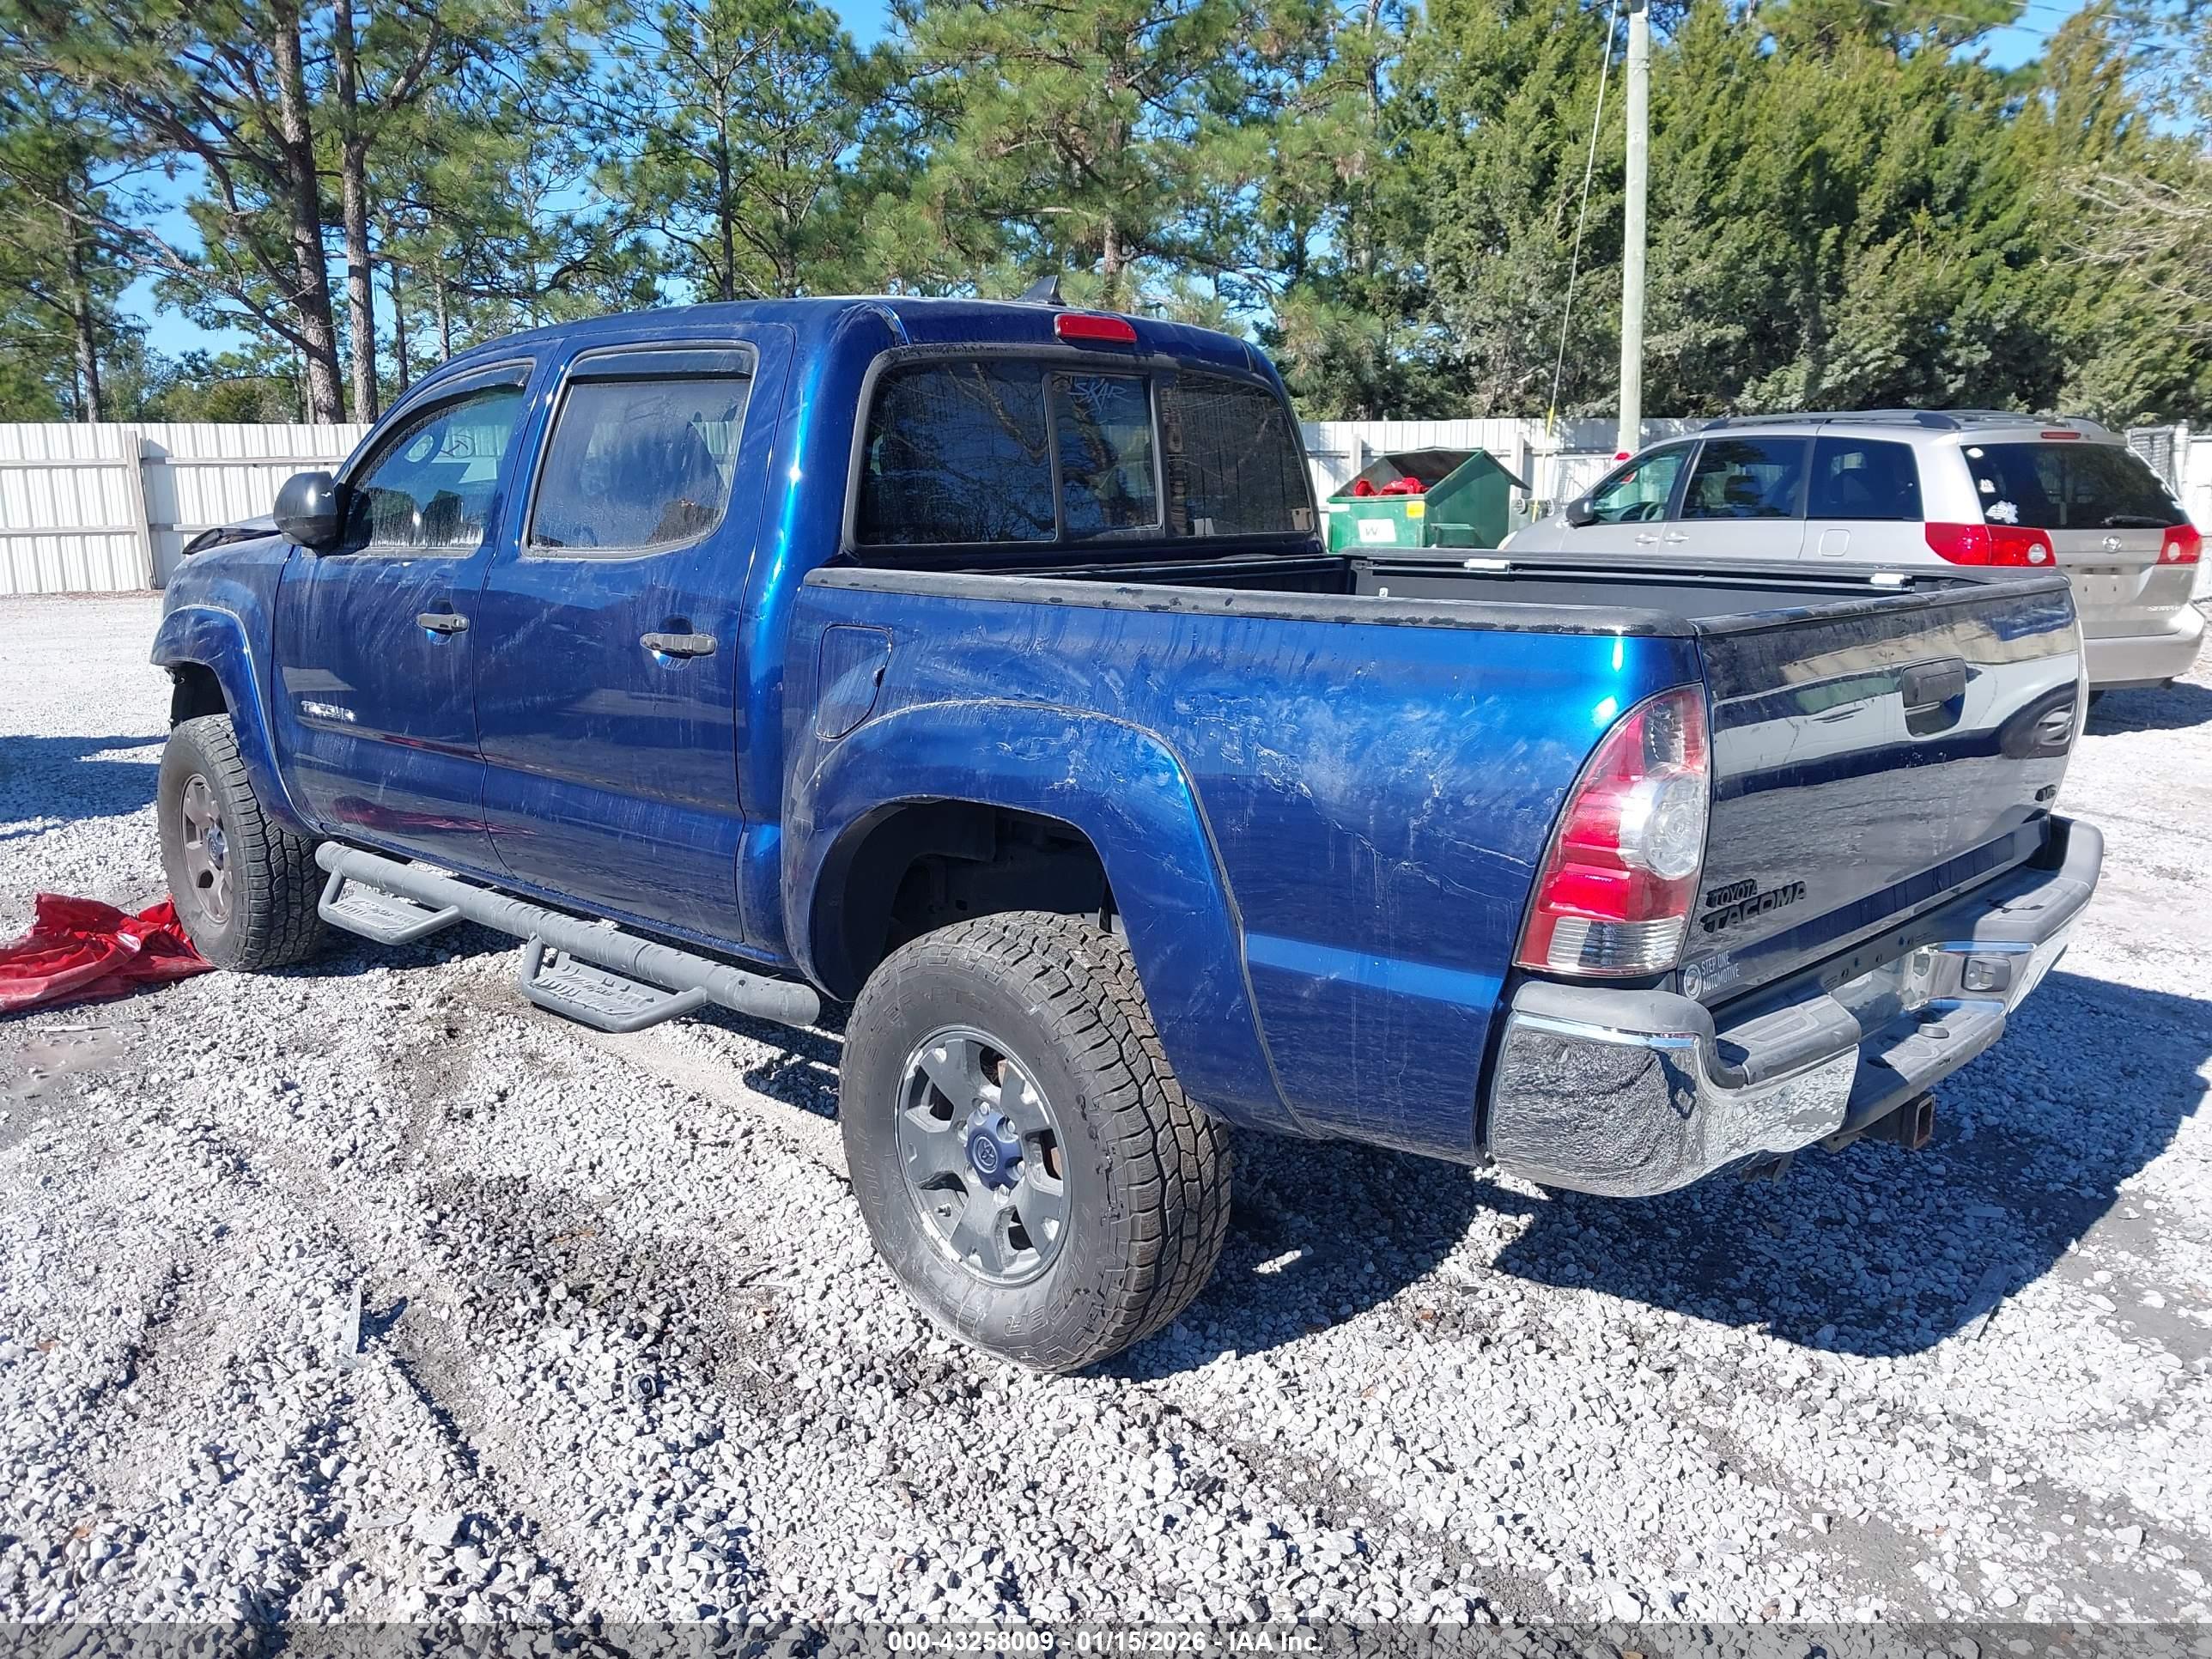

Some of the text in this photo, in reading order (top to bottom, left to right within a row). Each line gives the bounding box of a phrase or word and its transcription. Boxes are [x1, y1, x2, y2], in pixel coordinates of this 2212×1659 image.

[1700, 880, 1807, 933] TACOMA
[1705, 878, 1759, 908] TOYOTA
[1701, 950, 1730, 976] STEP ONE
[1703, 963, 1740, 994] AUTOMOTIVE
